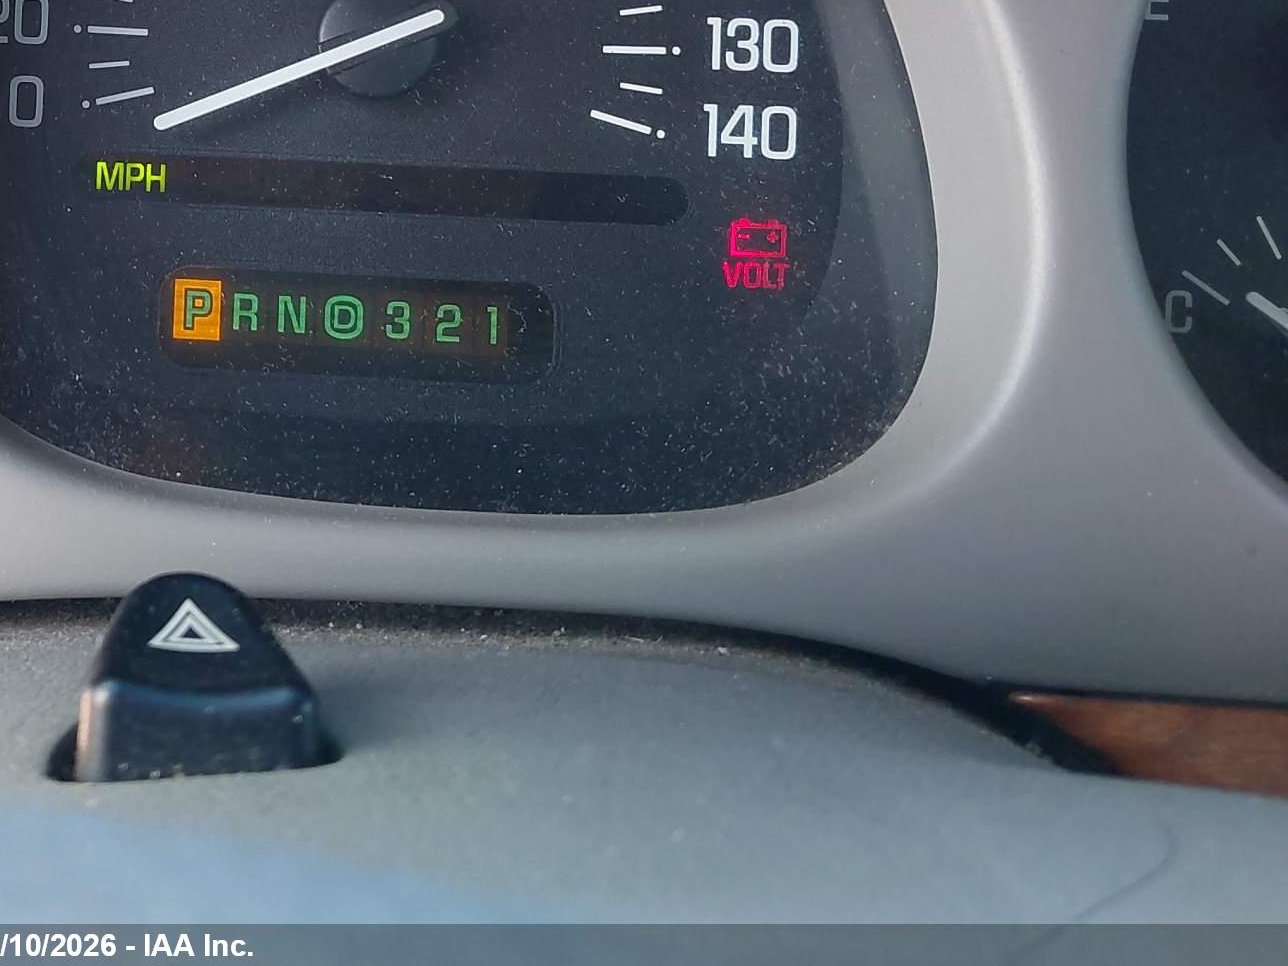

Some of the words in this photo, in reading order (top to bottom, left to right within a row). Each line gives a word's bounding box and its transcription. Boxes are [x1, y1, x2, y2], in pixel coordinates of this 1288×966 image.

[707, 16, 799, 73] 130
[703, 103, 798, 160] 140
[96, 161, 166, 192] MPH
[722, 261, 789, 290] VOLT
[185, 290, 212, 328] P
[233, 293, 258, 331] R
[278, 295, 307, 334] N
[386, 301, 410, 340] 3
[437, 304, 461, 343] 2
[487, 306, 498, 345] 1
[1165, 289, 1192, 333] C
